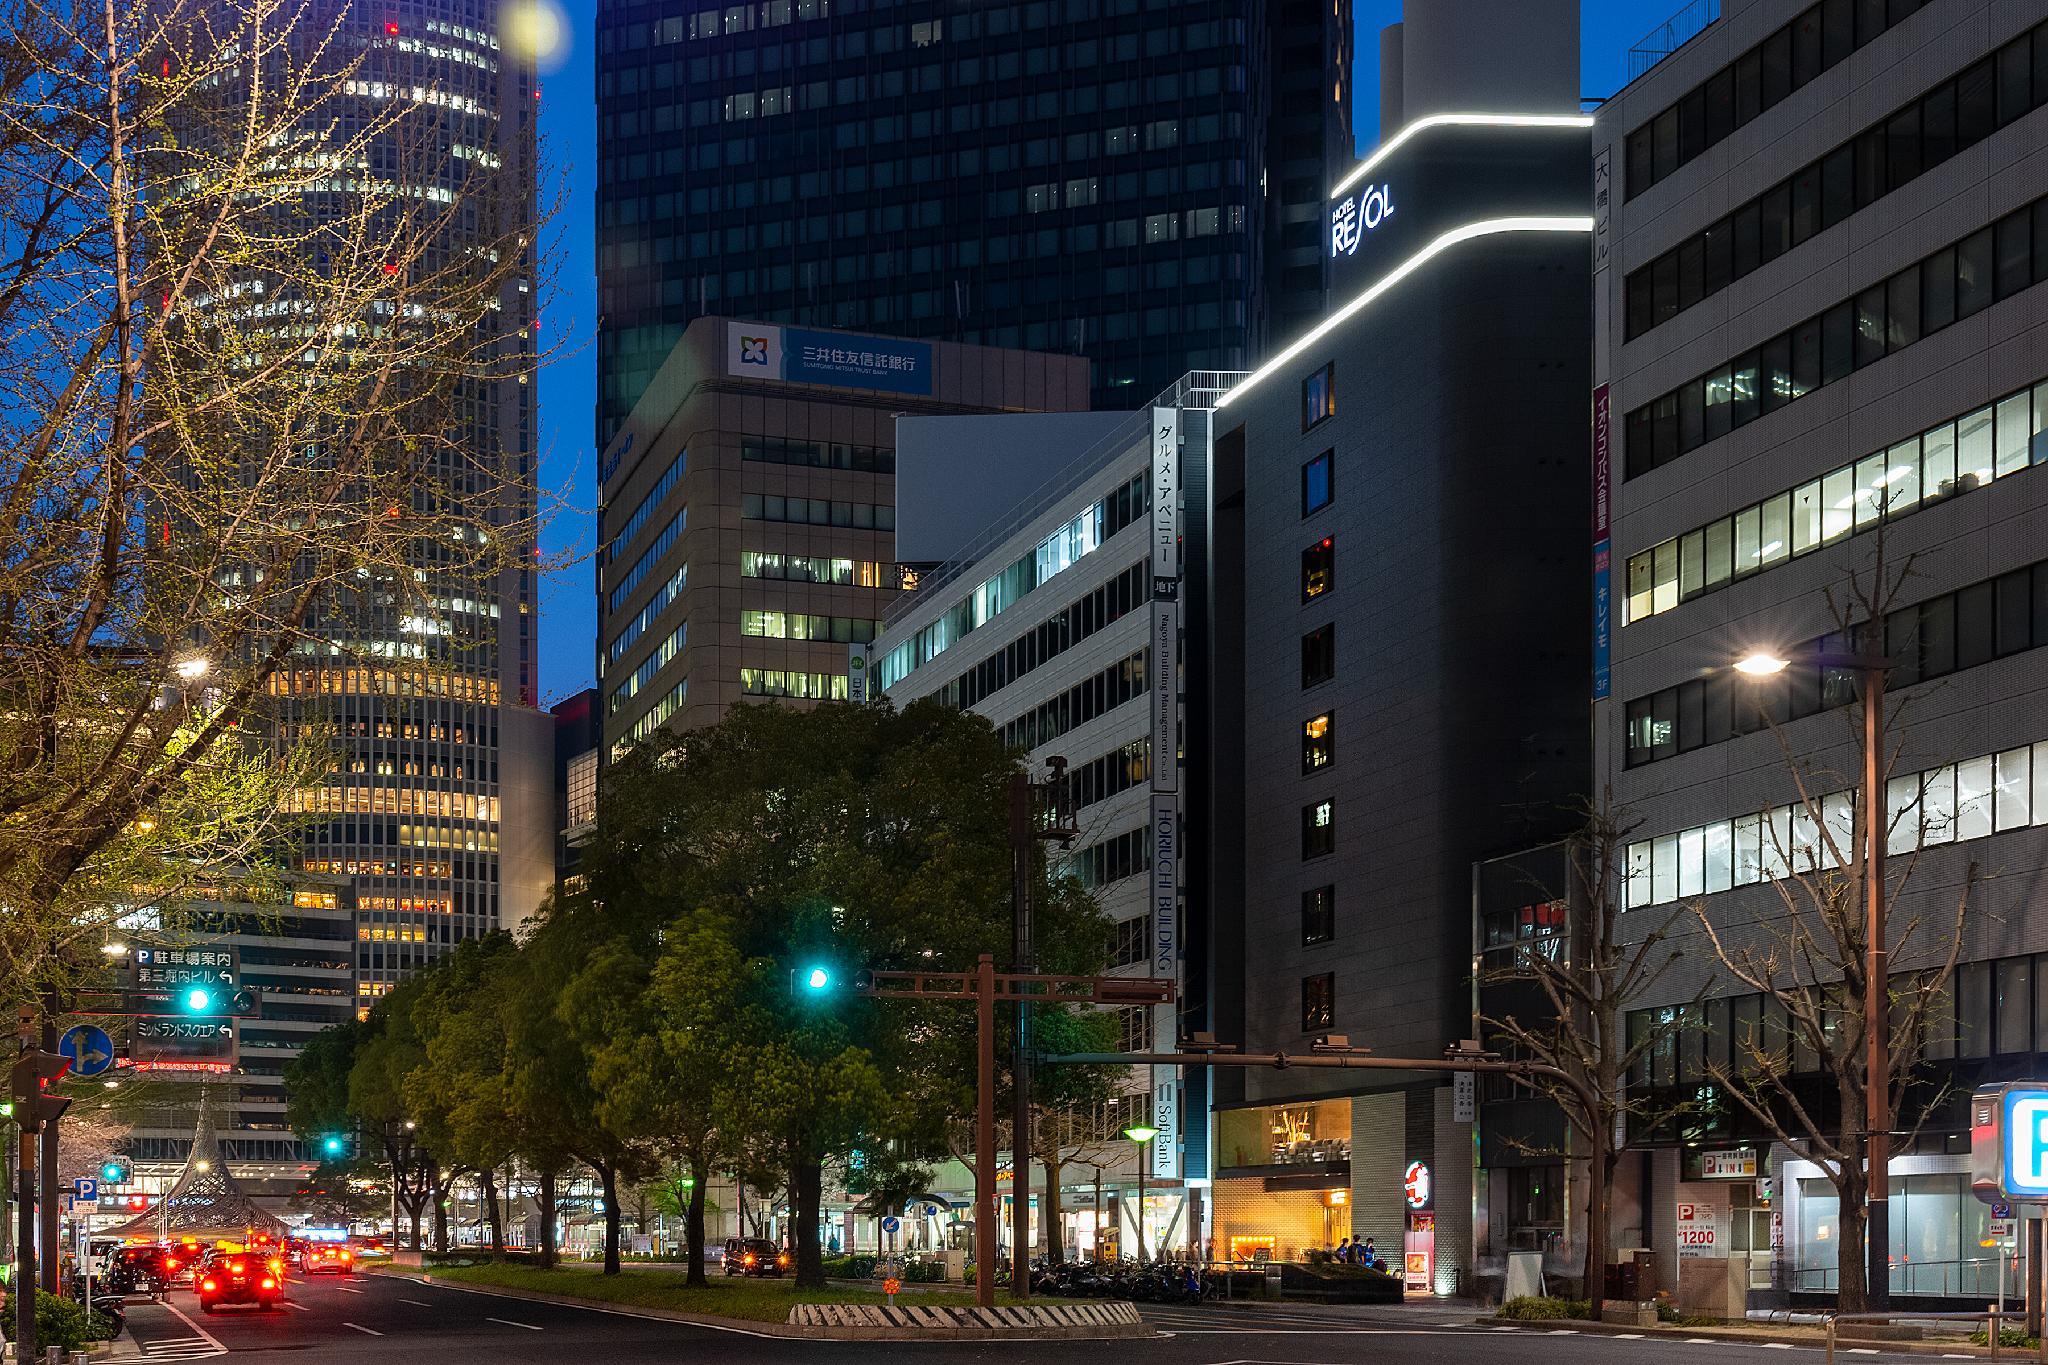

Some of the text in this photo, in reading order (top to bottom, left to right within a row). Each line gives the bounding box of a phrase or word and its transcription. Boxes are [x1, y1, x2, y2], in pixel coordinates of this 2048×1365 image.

[1332, 196, 1356, 224] HOTEL
[1332, 184, 1395, 258] RESOL
[802, 345, 916, 371] 三井住友信託銀行
[1158, 425, 1173, 563] グルメ・アベニュー
[1154, 581, 1175, 593] 地下
[1159, 613, 1169, 648] Nagoya
[1597, 586, 1608, 648] キレイモ
[1159, 651, 1169, 691] Building
[1159, 693, 1169, 756] Management
[1158, 809, 1173, 971] HORIUCHI BUILDING
[153, 950, 231, 967] 駐車場案内
[138, 968, 215, 984] 第三堀内ビル
[138, 1021, 215, 1038] ミッドランドスクエア
[1158, 1105, 1172, 1168] SoftBank
[1725, 1163, 1735, 1173] IN
[80, 1180, 94, 1199] P
[1680, 1205, 1693, 1220] P
